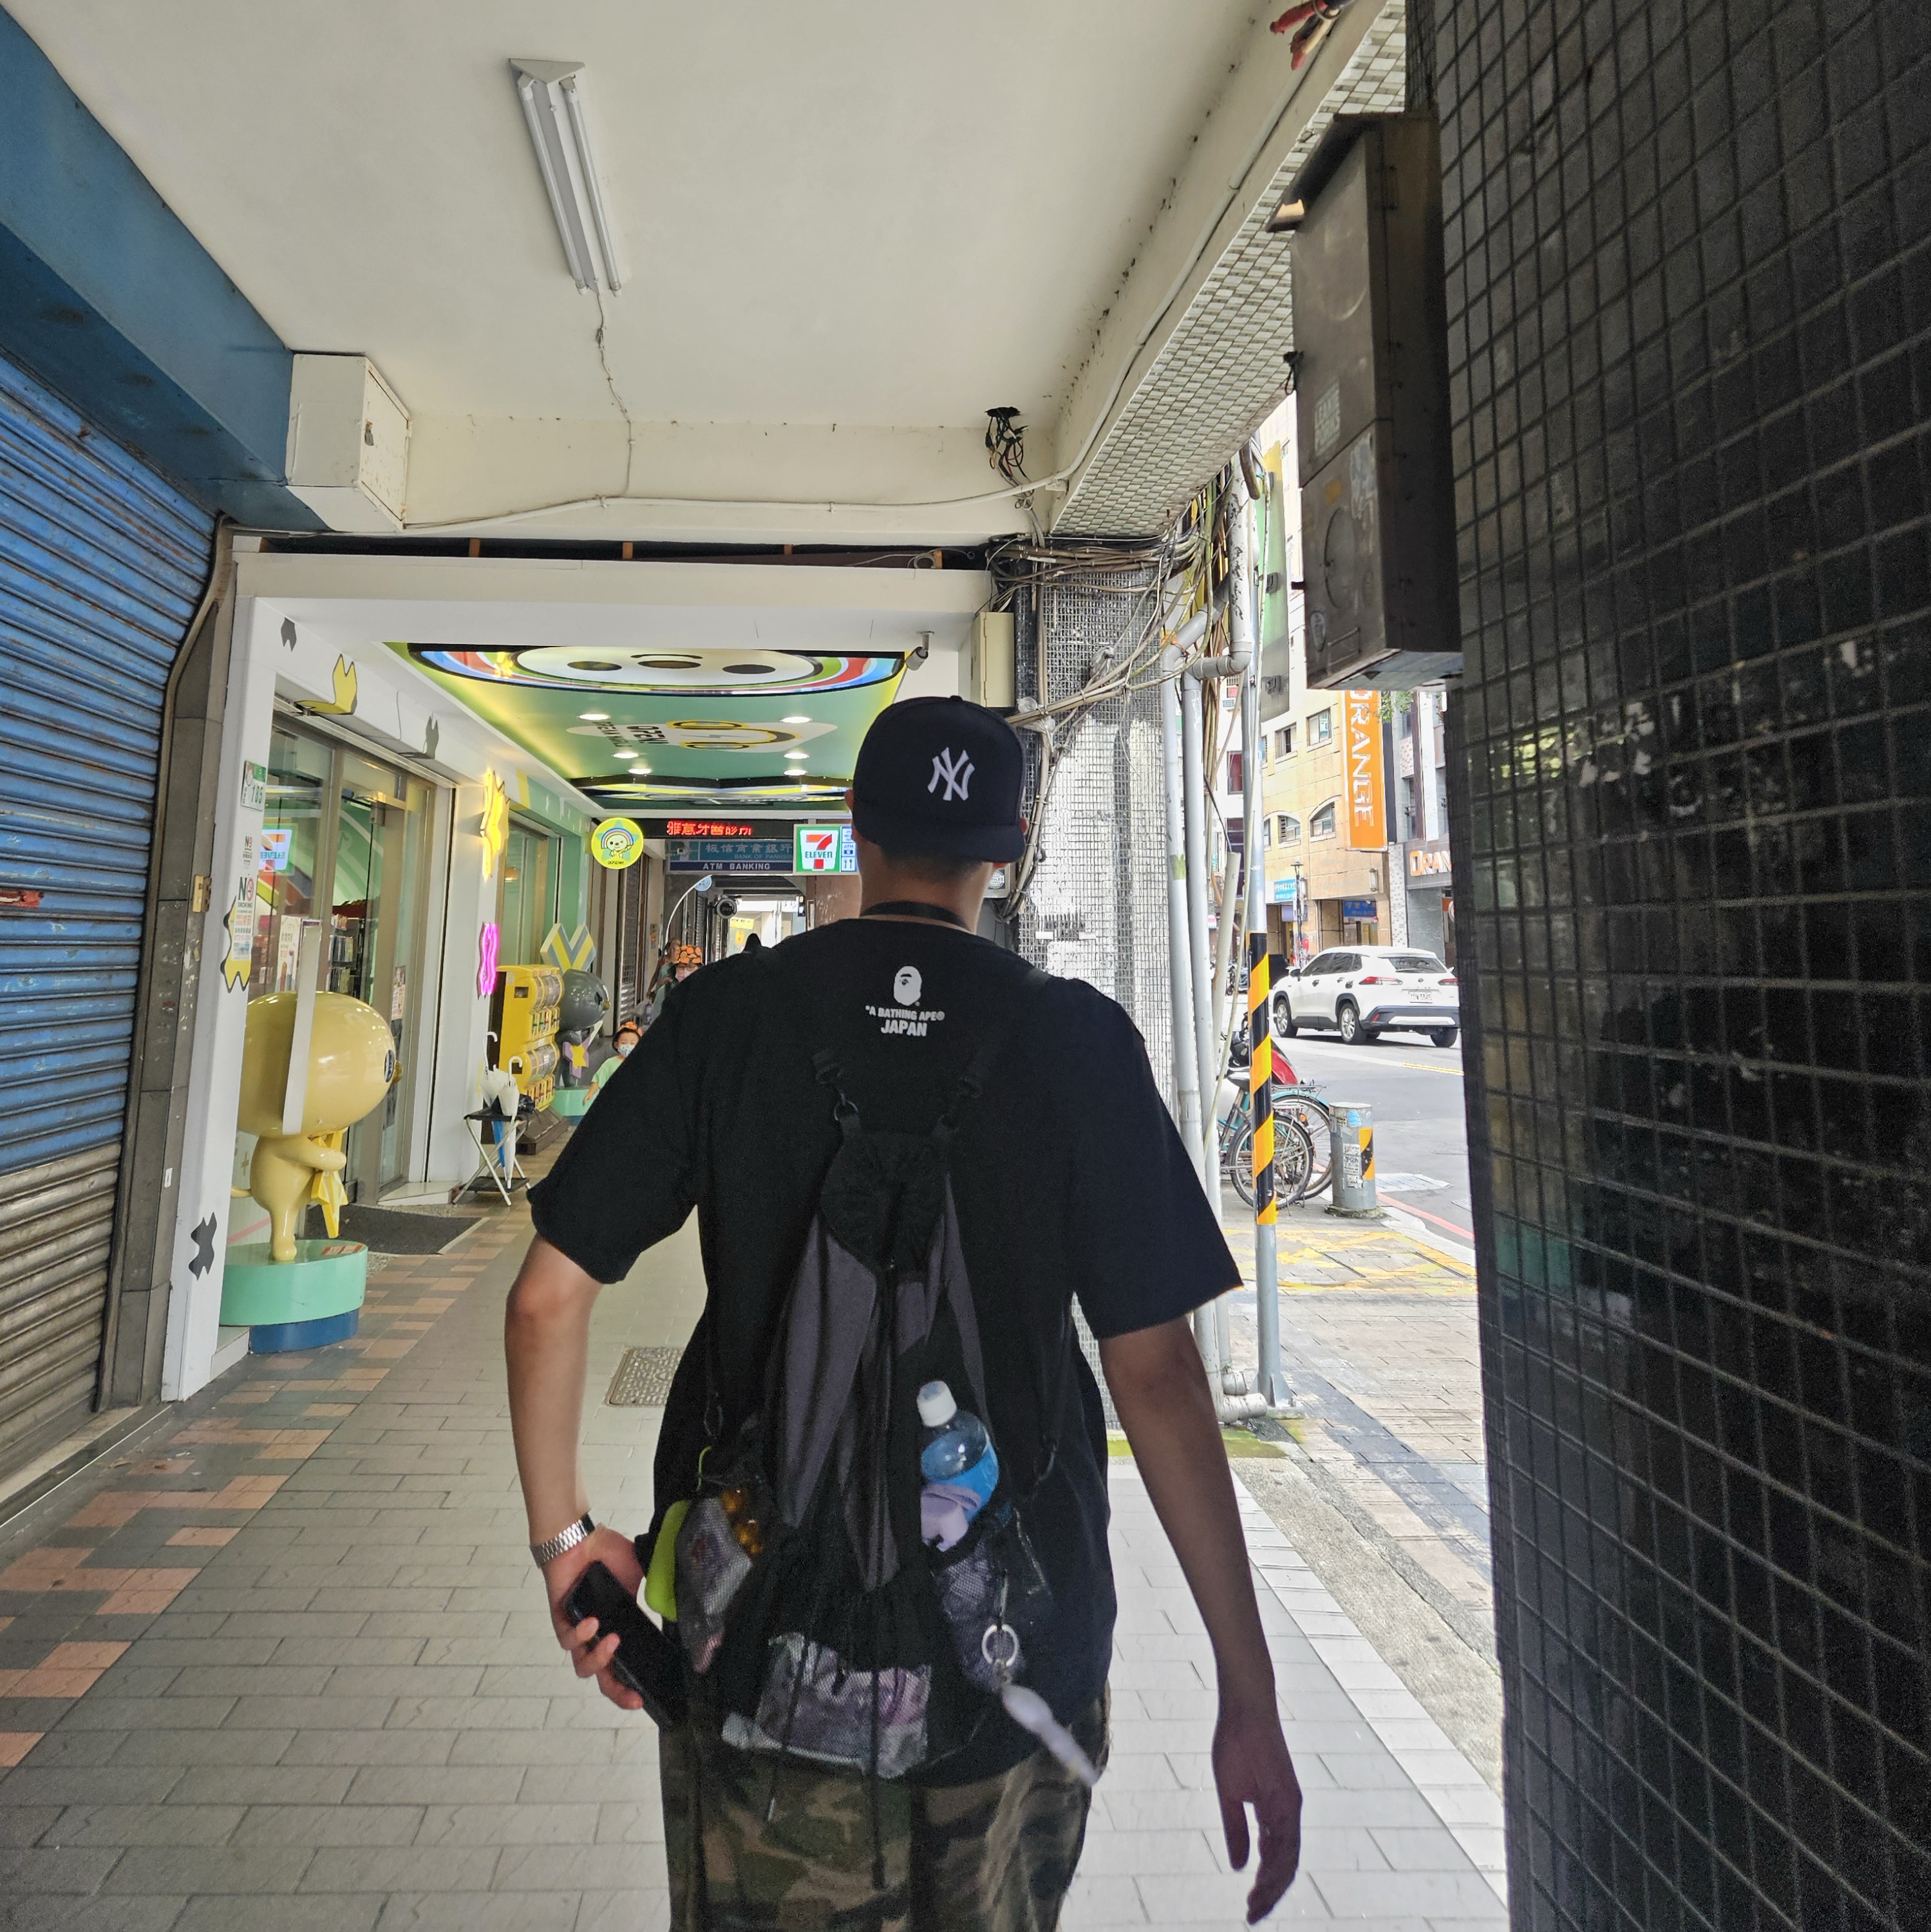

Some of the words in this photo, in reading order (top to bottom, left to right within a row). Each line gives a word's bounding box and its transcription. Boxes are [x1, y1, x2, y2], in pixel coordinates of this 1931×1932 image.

[927, 747, 975, 801] NY
[705, 844, 793, 853] 板信商業銀行
[878, 1007, 917, 1021] BATHING
[881, 1019, 927, 1037] JAPAN
